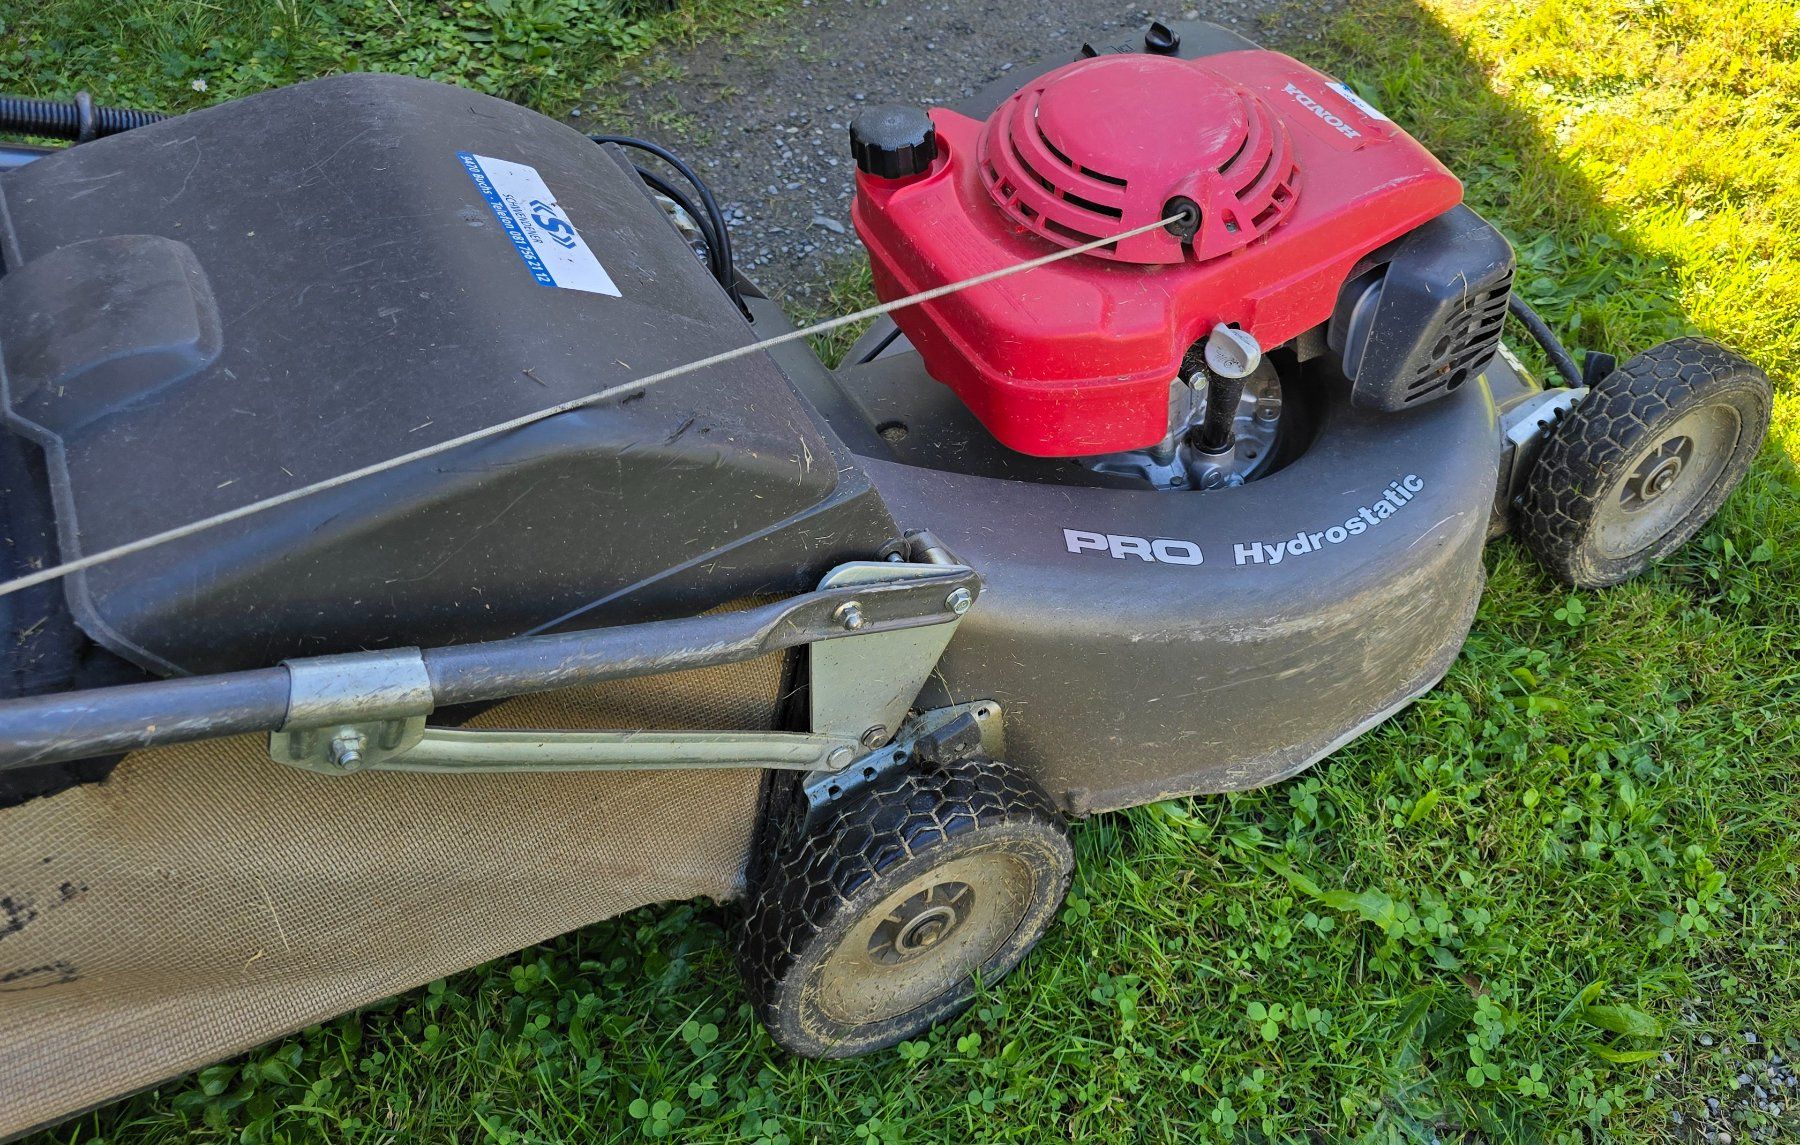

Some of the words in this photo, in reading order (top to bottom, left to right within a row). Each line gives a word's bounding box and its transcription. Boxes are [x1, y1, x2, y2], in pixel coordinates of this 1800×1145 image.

[1281, 82, 1361, 138] HONDA
[460, 155, 480, 173] 9470
[472, 173, 493, 195] Buchs
[490, 201, 514, 229] Telefon
[502, 193, 543, 246] SCHWENDENER
[509, 230, 527, 245] 081
[519, 245, 537, 260] 756
[528, 260, 544, 271] 21
[535, 272, 551, 283] 12
[1062, 528, 1204, 566] PRO
[1233, 473, 1425, 566] Hydrostatic
